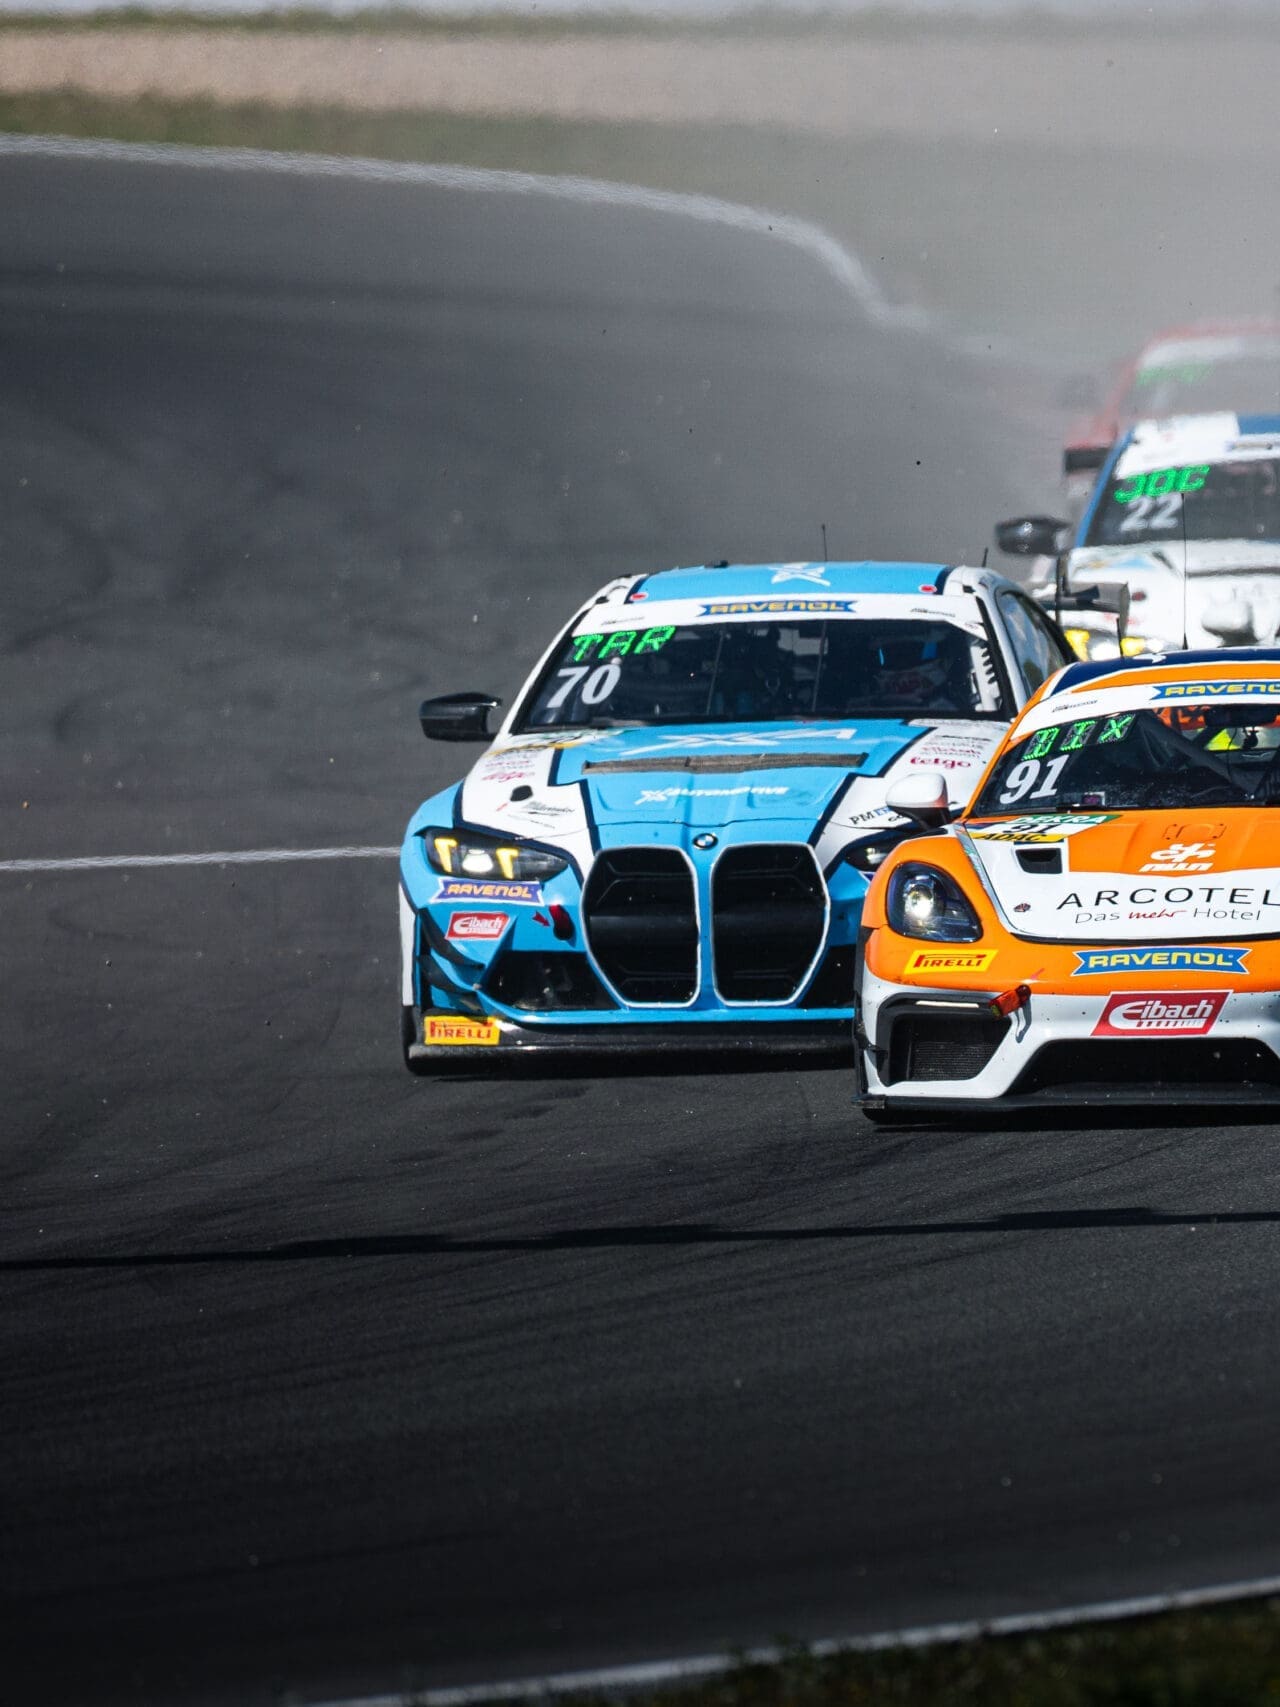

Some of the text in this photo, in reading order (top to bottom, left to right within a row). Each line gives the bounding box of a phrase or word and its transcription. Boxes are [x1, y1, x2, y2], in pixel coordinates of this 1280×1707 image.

[1119, 492, 1183, 532] 22
[709, 602, 845, 614] RAVENOL
[572, 625, 676, 662] TAR
[546, 664, 621, 708] 70
[1000, 754, 1070, 804] 91
[1005, 815, 1107, 824] DEKRA
[977, 833, 1047, 842] ADAC
[447, 884, 532, 898] RAVENOL
[1056, 887, 1280, 910] ARCOTEL
[1075, 907, 1261, 924] Das mehr Hotel
[453, 917, 504, 935] Eibach
[913, 954, 987, 968] PIRELLI
[1089, 952, 1233, 968] RAVENOL
[1108, 1000, 1213, 1029] Eibach
[430, 1021, 494, 1039] PIRELLI
